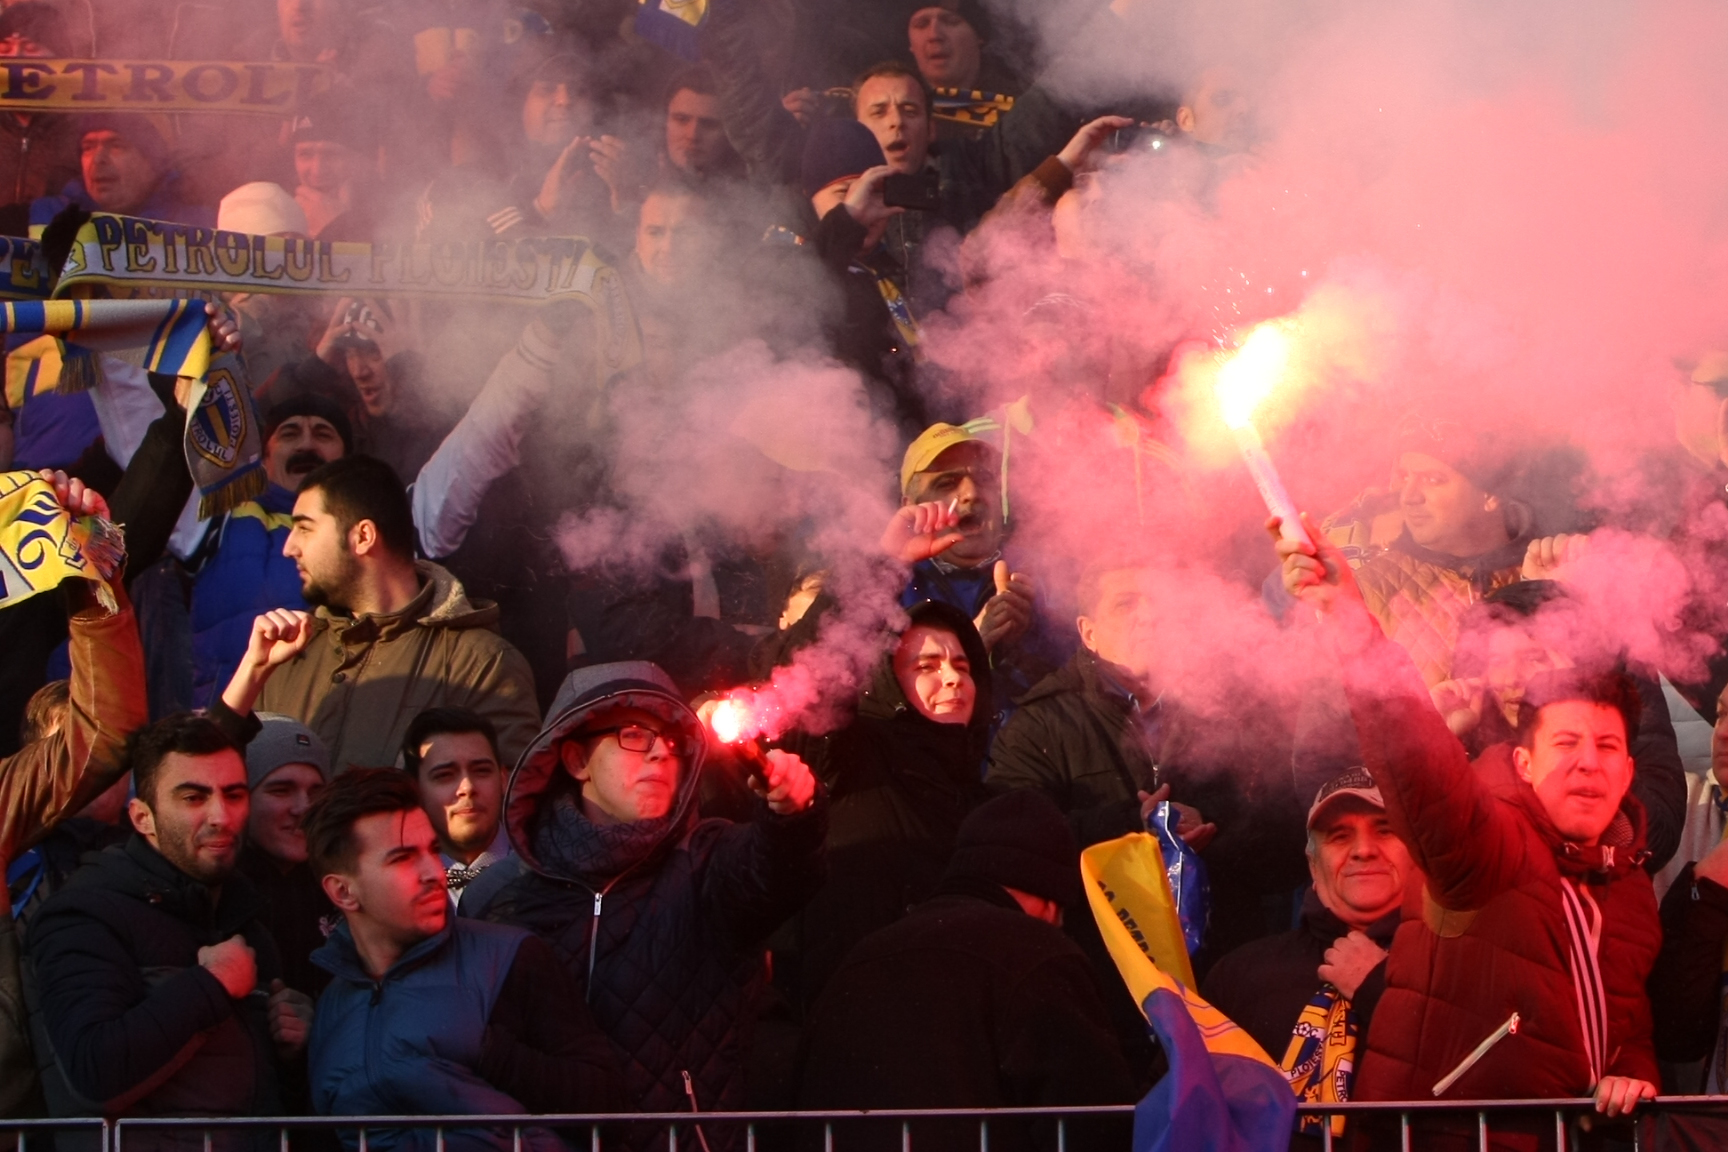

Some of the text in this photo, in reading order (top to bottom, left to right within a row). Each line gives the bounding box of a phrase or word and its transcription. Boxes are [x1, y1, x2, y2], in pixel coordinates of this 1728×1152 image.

[93, 215, 351, 284] PETROLUL
[191, 419, 227, 460] TROLUL
[1290, 1042, 1324, 1078] PLOIEST
